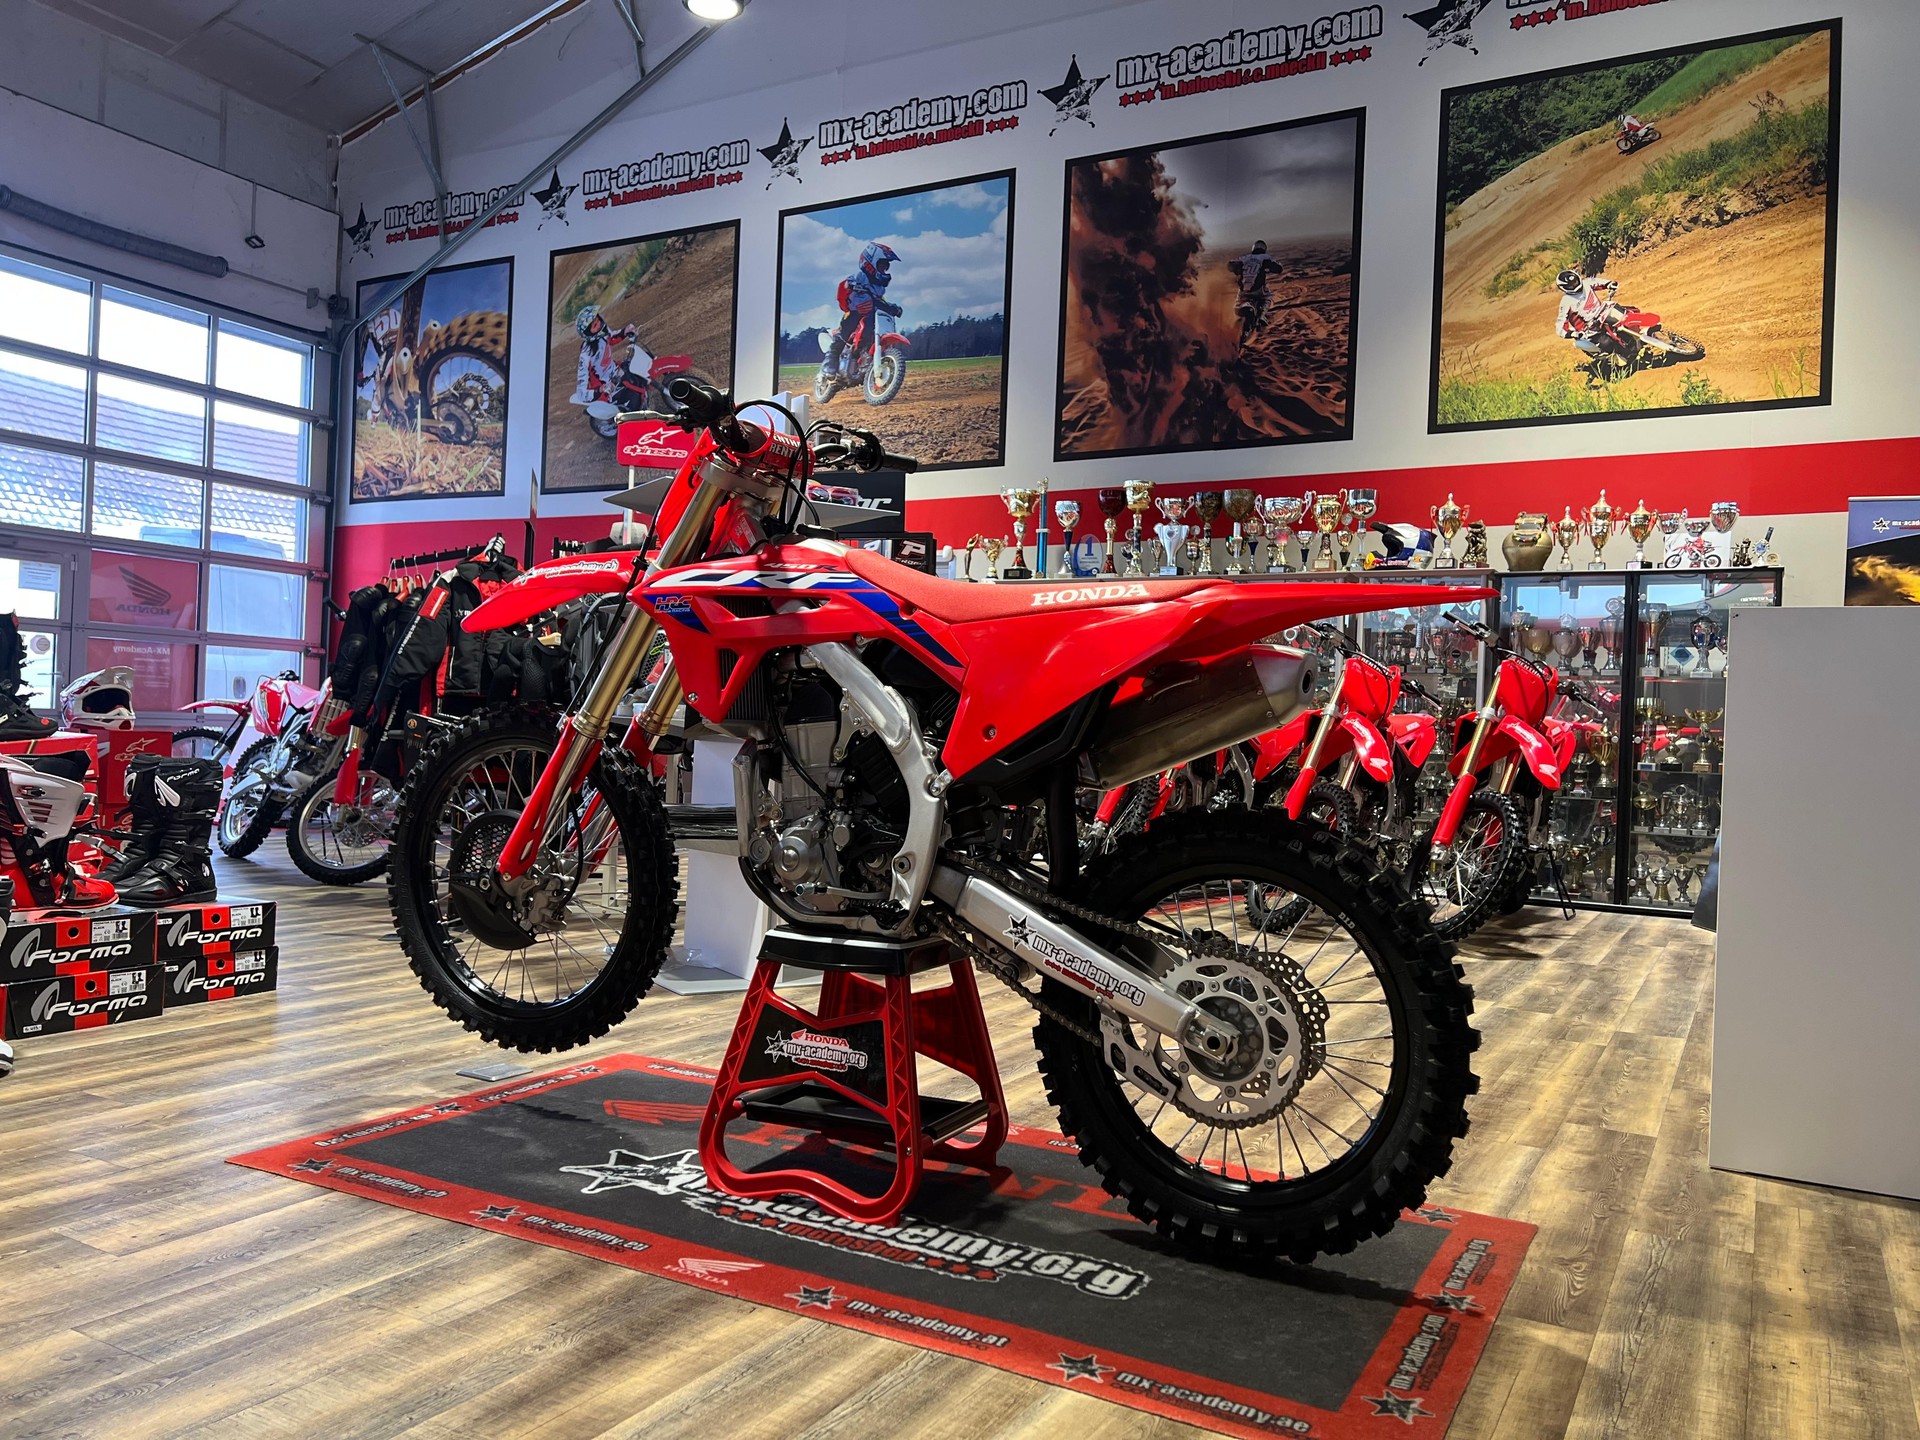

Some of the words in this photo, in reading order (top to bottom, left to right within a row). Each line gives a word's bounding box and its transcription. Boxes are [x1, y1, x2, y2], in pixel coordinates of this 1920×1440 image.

[1116, 4, 1383, 88] mx-academy.com
[819, 80, 1028, 149] mx-academy.com
[582, 139, 750, 195] mx-academy.com
[623, 445, 688, 459] alpinestars
[1085, 535, 1094, 556] 1
[649, 568, 861, 590] CRF
[655, 595, 693, 611] HRC
[1031, 583, 1150, 606] HONDA
[178, 927, 262, 946] Forma
[25, 944, 132, 967] Forma
[184, 972, 265, 994] Forma
[1032, 935, 1147, 1007] mx-academy.org
[45, 994, 148, 1021] Forma
[805, 1034, 849, 1047] HONDA
[786, 1042, 867, 1067] mx-academy.org
[334, 1165, 450, 1199] mx-academy.ch
[522, 1213, 652, 1252] mx-academy.eu
[782, 1222, 920, 1262] motoshop
[663, 1264, 730, 1286] HONDA
[845, 1299, 1012, 1348] mx-academy.at
[1387, 1313, 1449, 1391] mx-academy.com
[1113, 1370, 1313, 1433] mx-academy.ae
